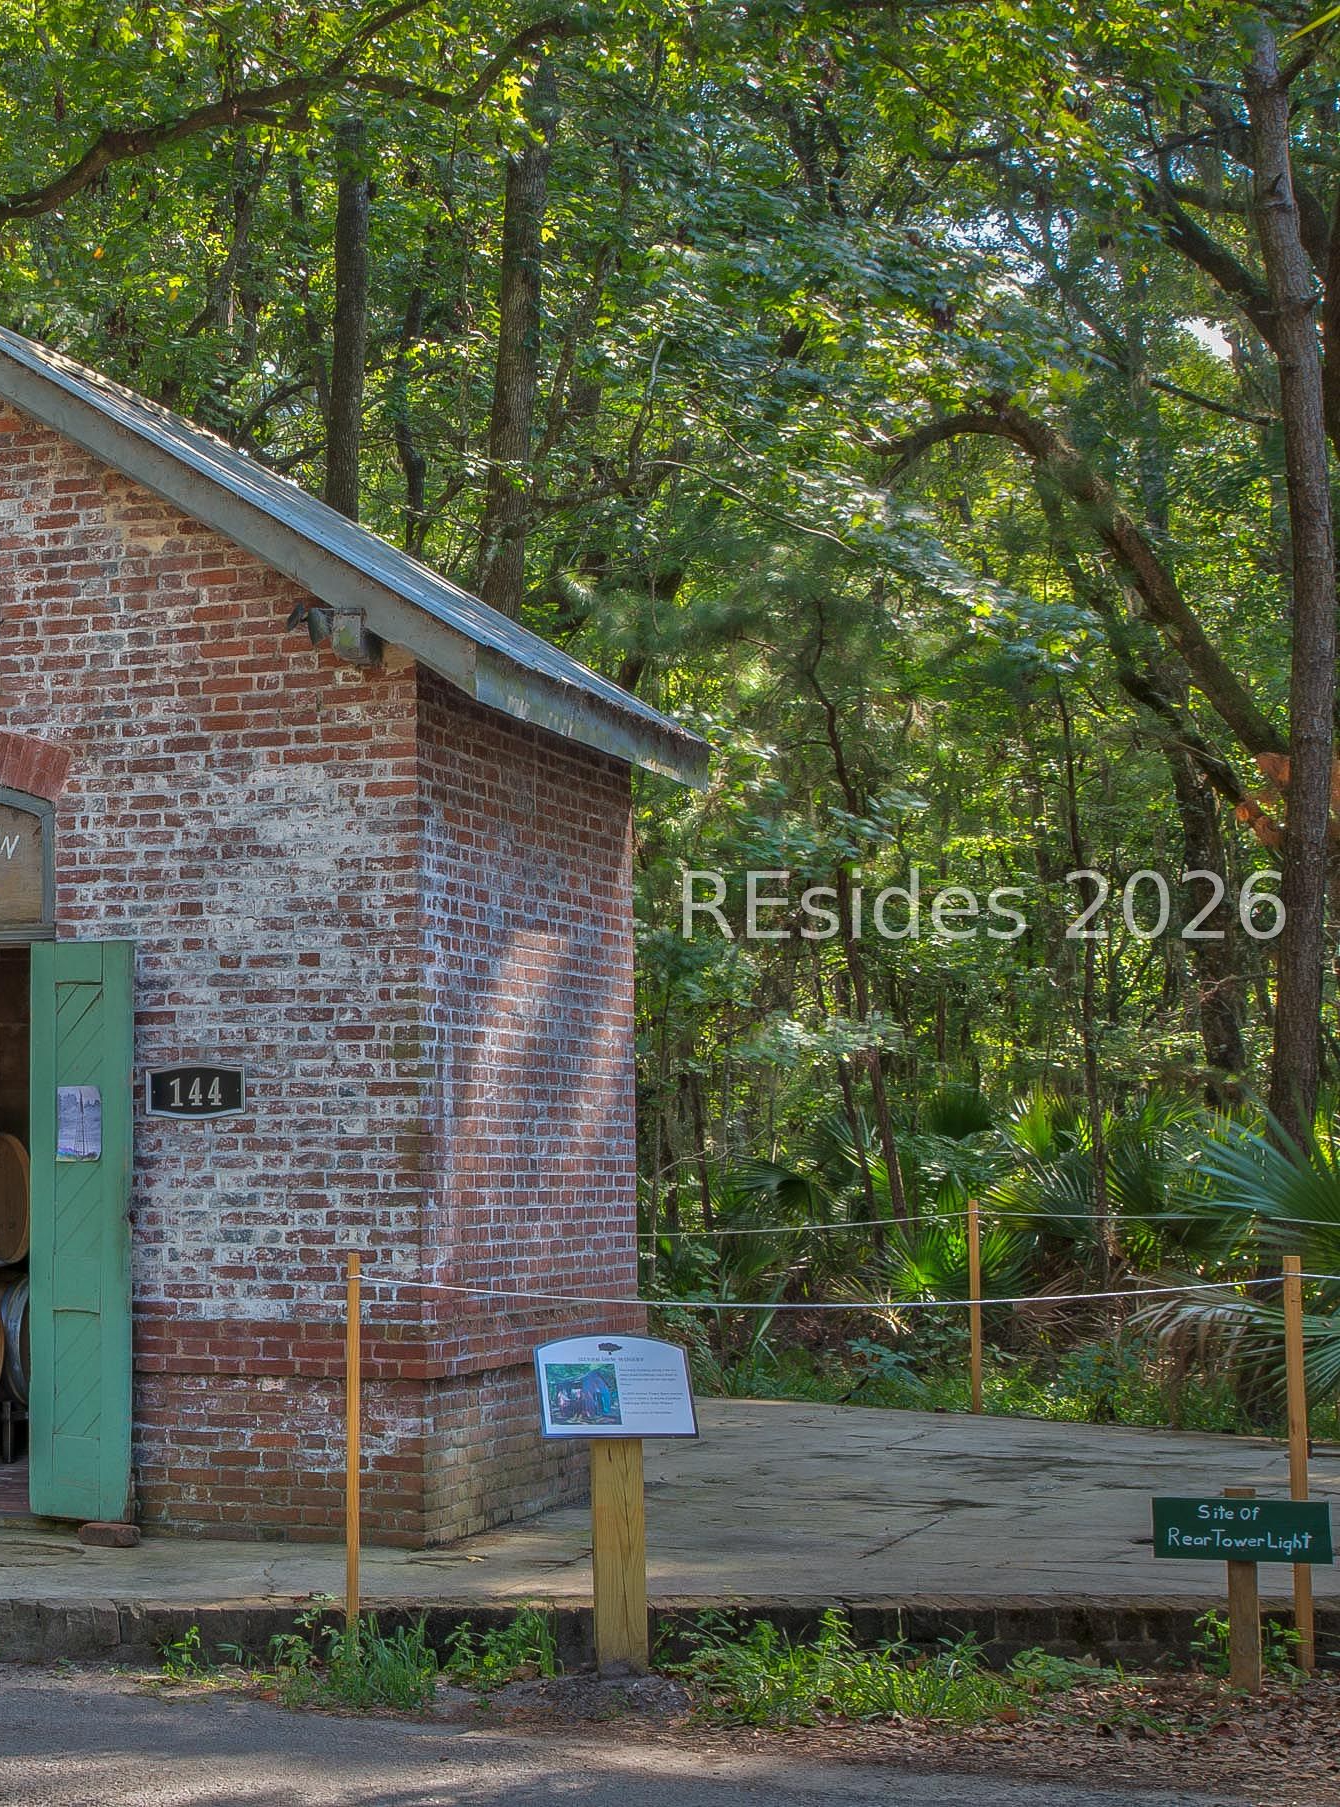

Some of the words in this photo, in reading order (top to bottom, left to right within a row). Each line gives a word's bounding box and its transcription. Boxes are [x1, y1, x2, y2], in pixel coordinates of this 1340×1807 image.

[169, 1076, 223, 1107] 144
[1197, 1504, 1234, 1519] Site
[1240, 1507, 1260, 1520] Of
